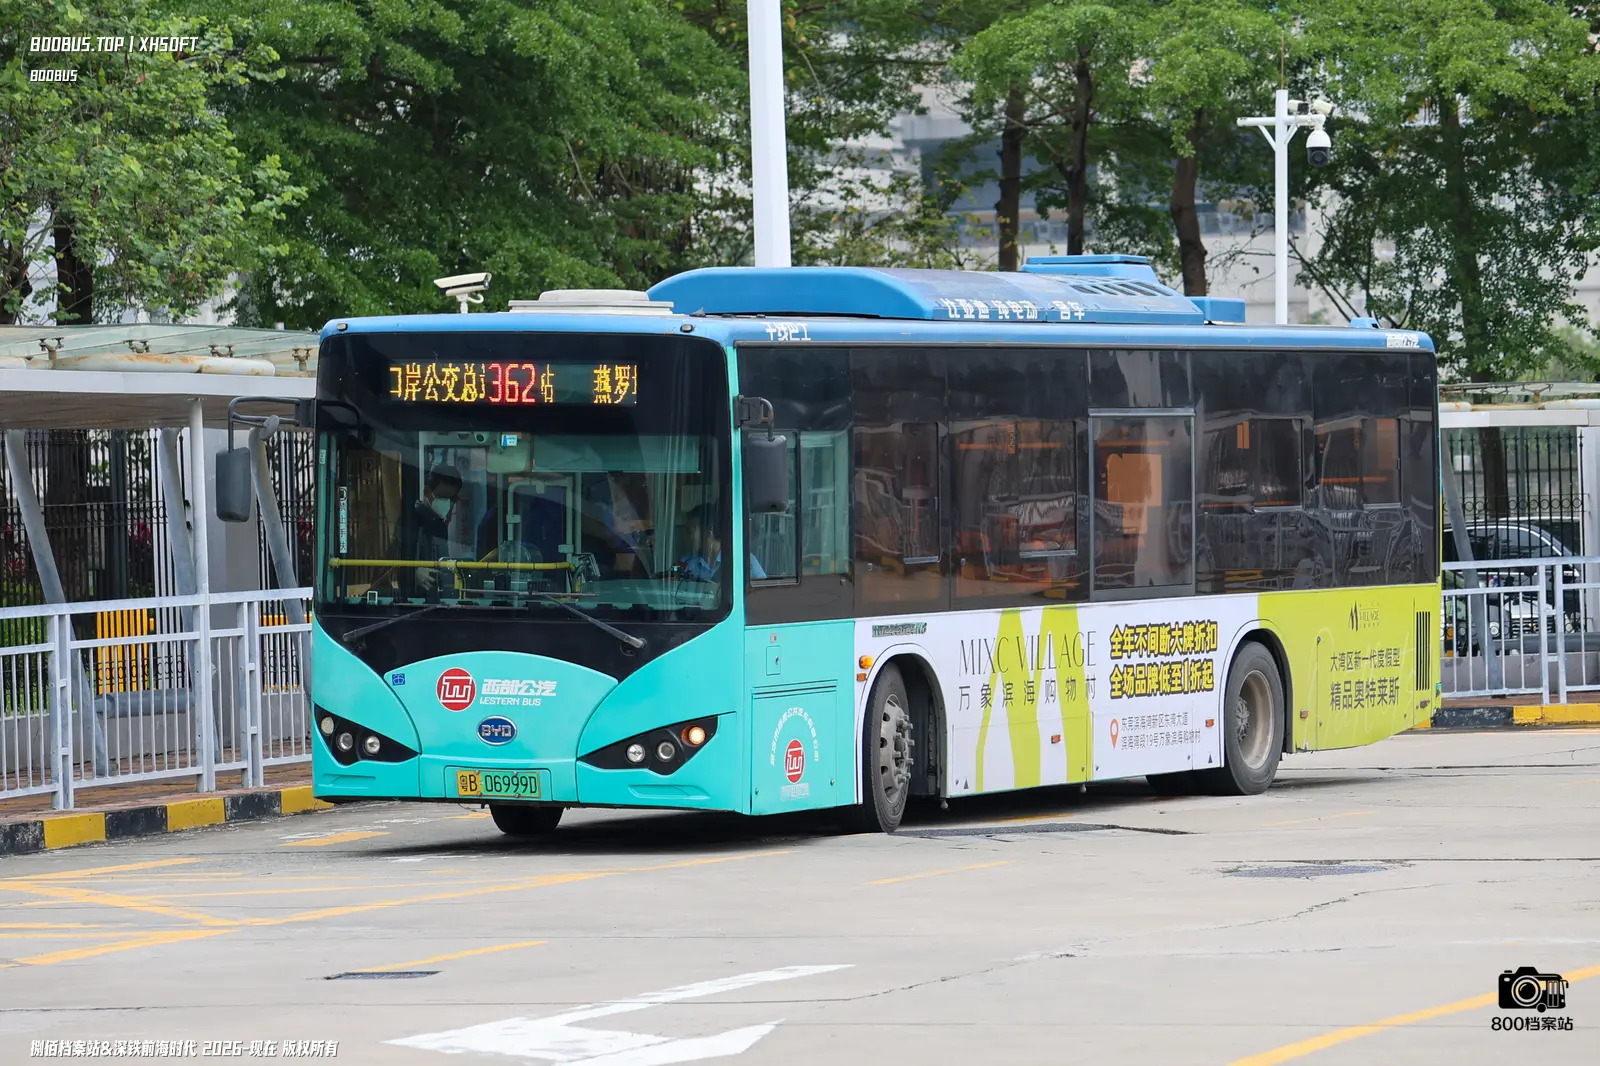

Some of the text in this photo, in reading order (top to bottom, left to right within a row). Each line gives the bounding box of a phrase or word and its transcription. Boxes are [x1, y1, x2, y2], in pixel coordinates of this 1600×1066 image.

[488, 362, 536, 403] 362
[958, 631, 1097, 677] MIXC VILLAGE
[1110, 620, 1218, 660] 全年不间断大牌折扣
[1330, 647, 1400, 672] 大湾区新一代度假型
[481, 678, 557, 697] 西部公汽
[958, 674, 1097, 712] 万象滨海购物村
[1109, 658, 1215, 700] 全场品牌低至1折起
[1330, 676, 1400, 711] 精品奥特莱斯
[522, 697, 542, 707] BUS
[481, 724, 512, 737] BYD
[484, 774, 537, 794] 06999D
